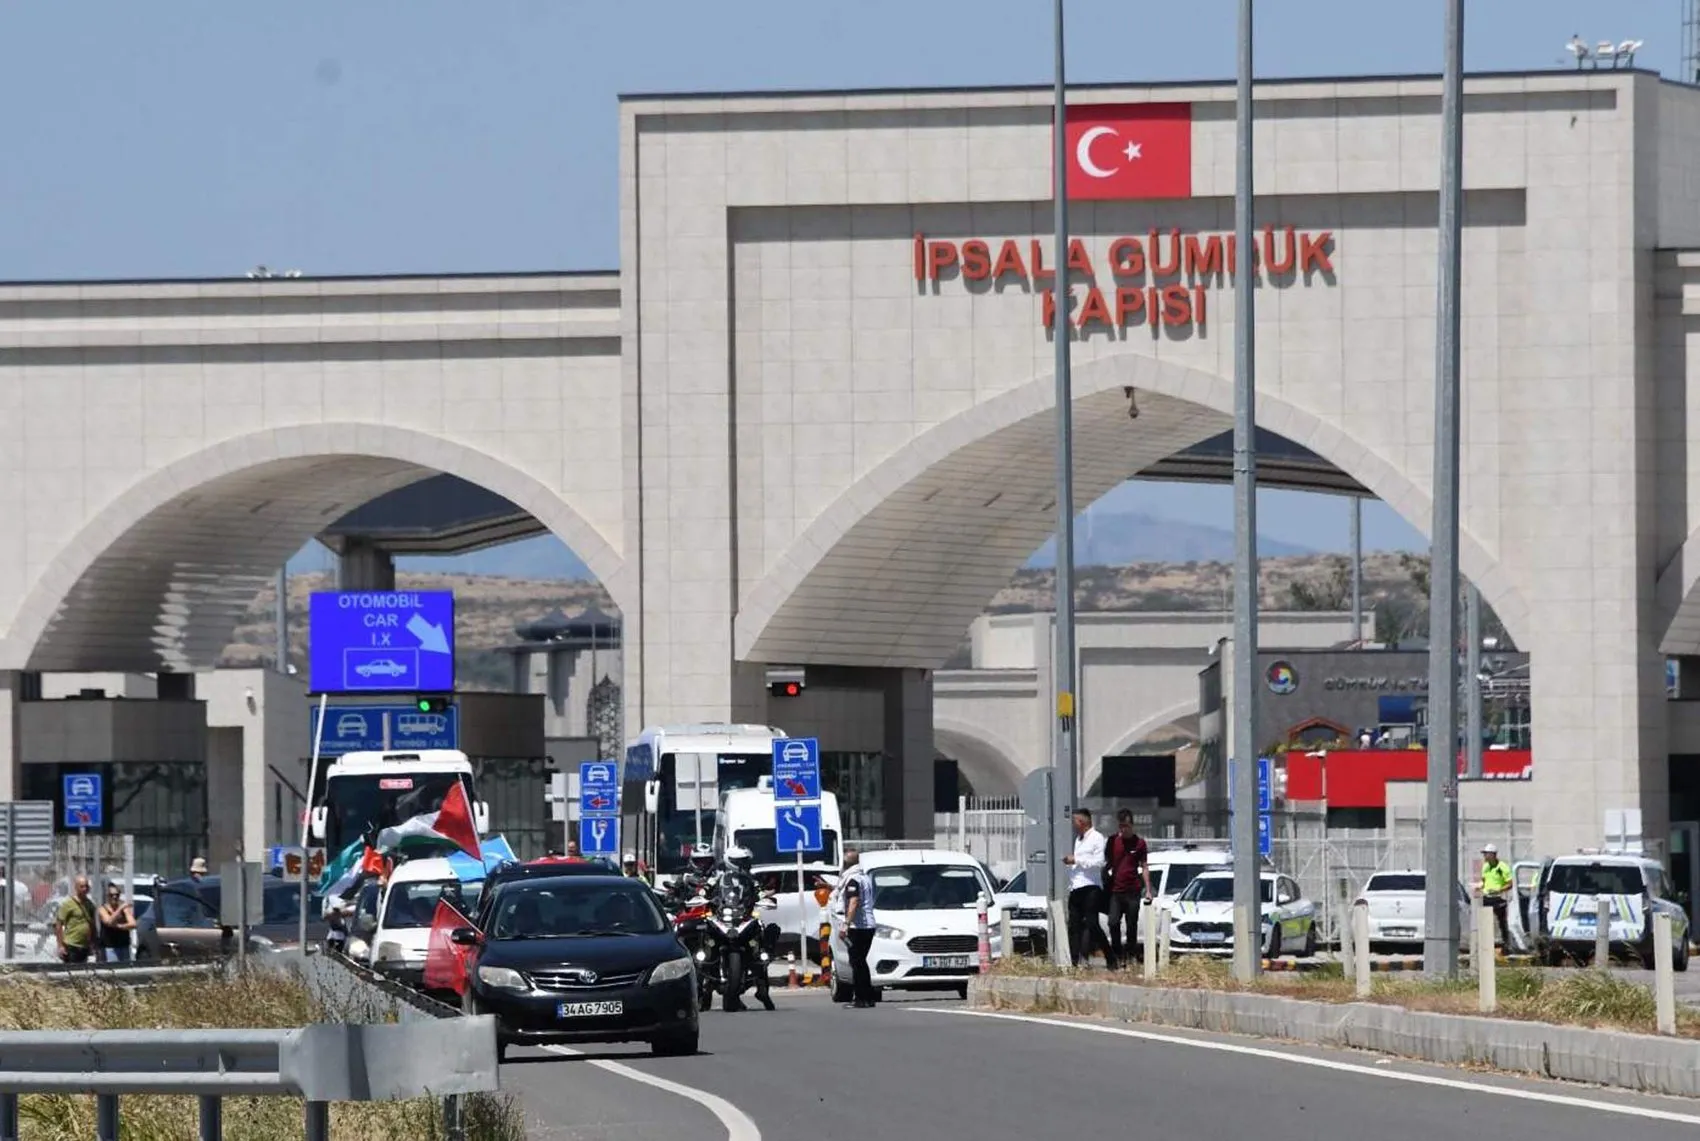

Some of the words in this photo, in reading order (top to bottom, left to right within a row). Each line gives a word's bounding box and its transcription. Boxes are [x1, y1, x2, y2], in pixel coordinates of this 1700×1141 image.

[914, 231, 1094, 281] İPSALA
[1042, 283, 1206, 328] KAPISI
[363, 613, 399, 627] CAR
